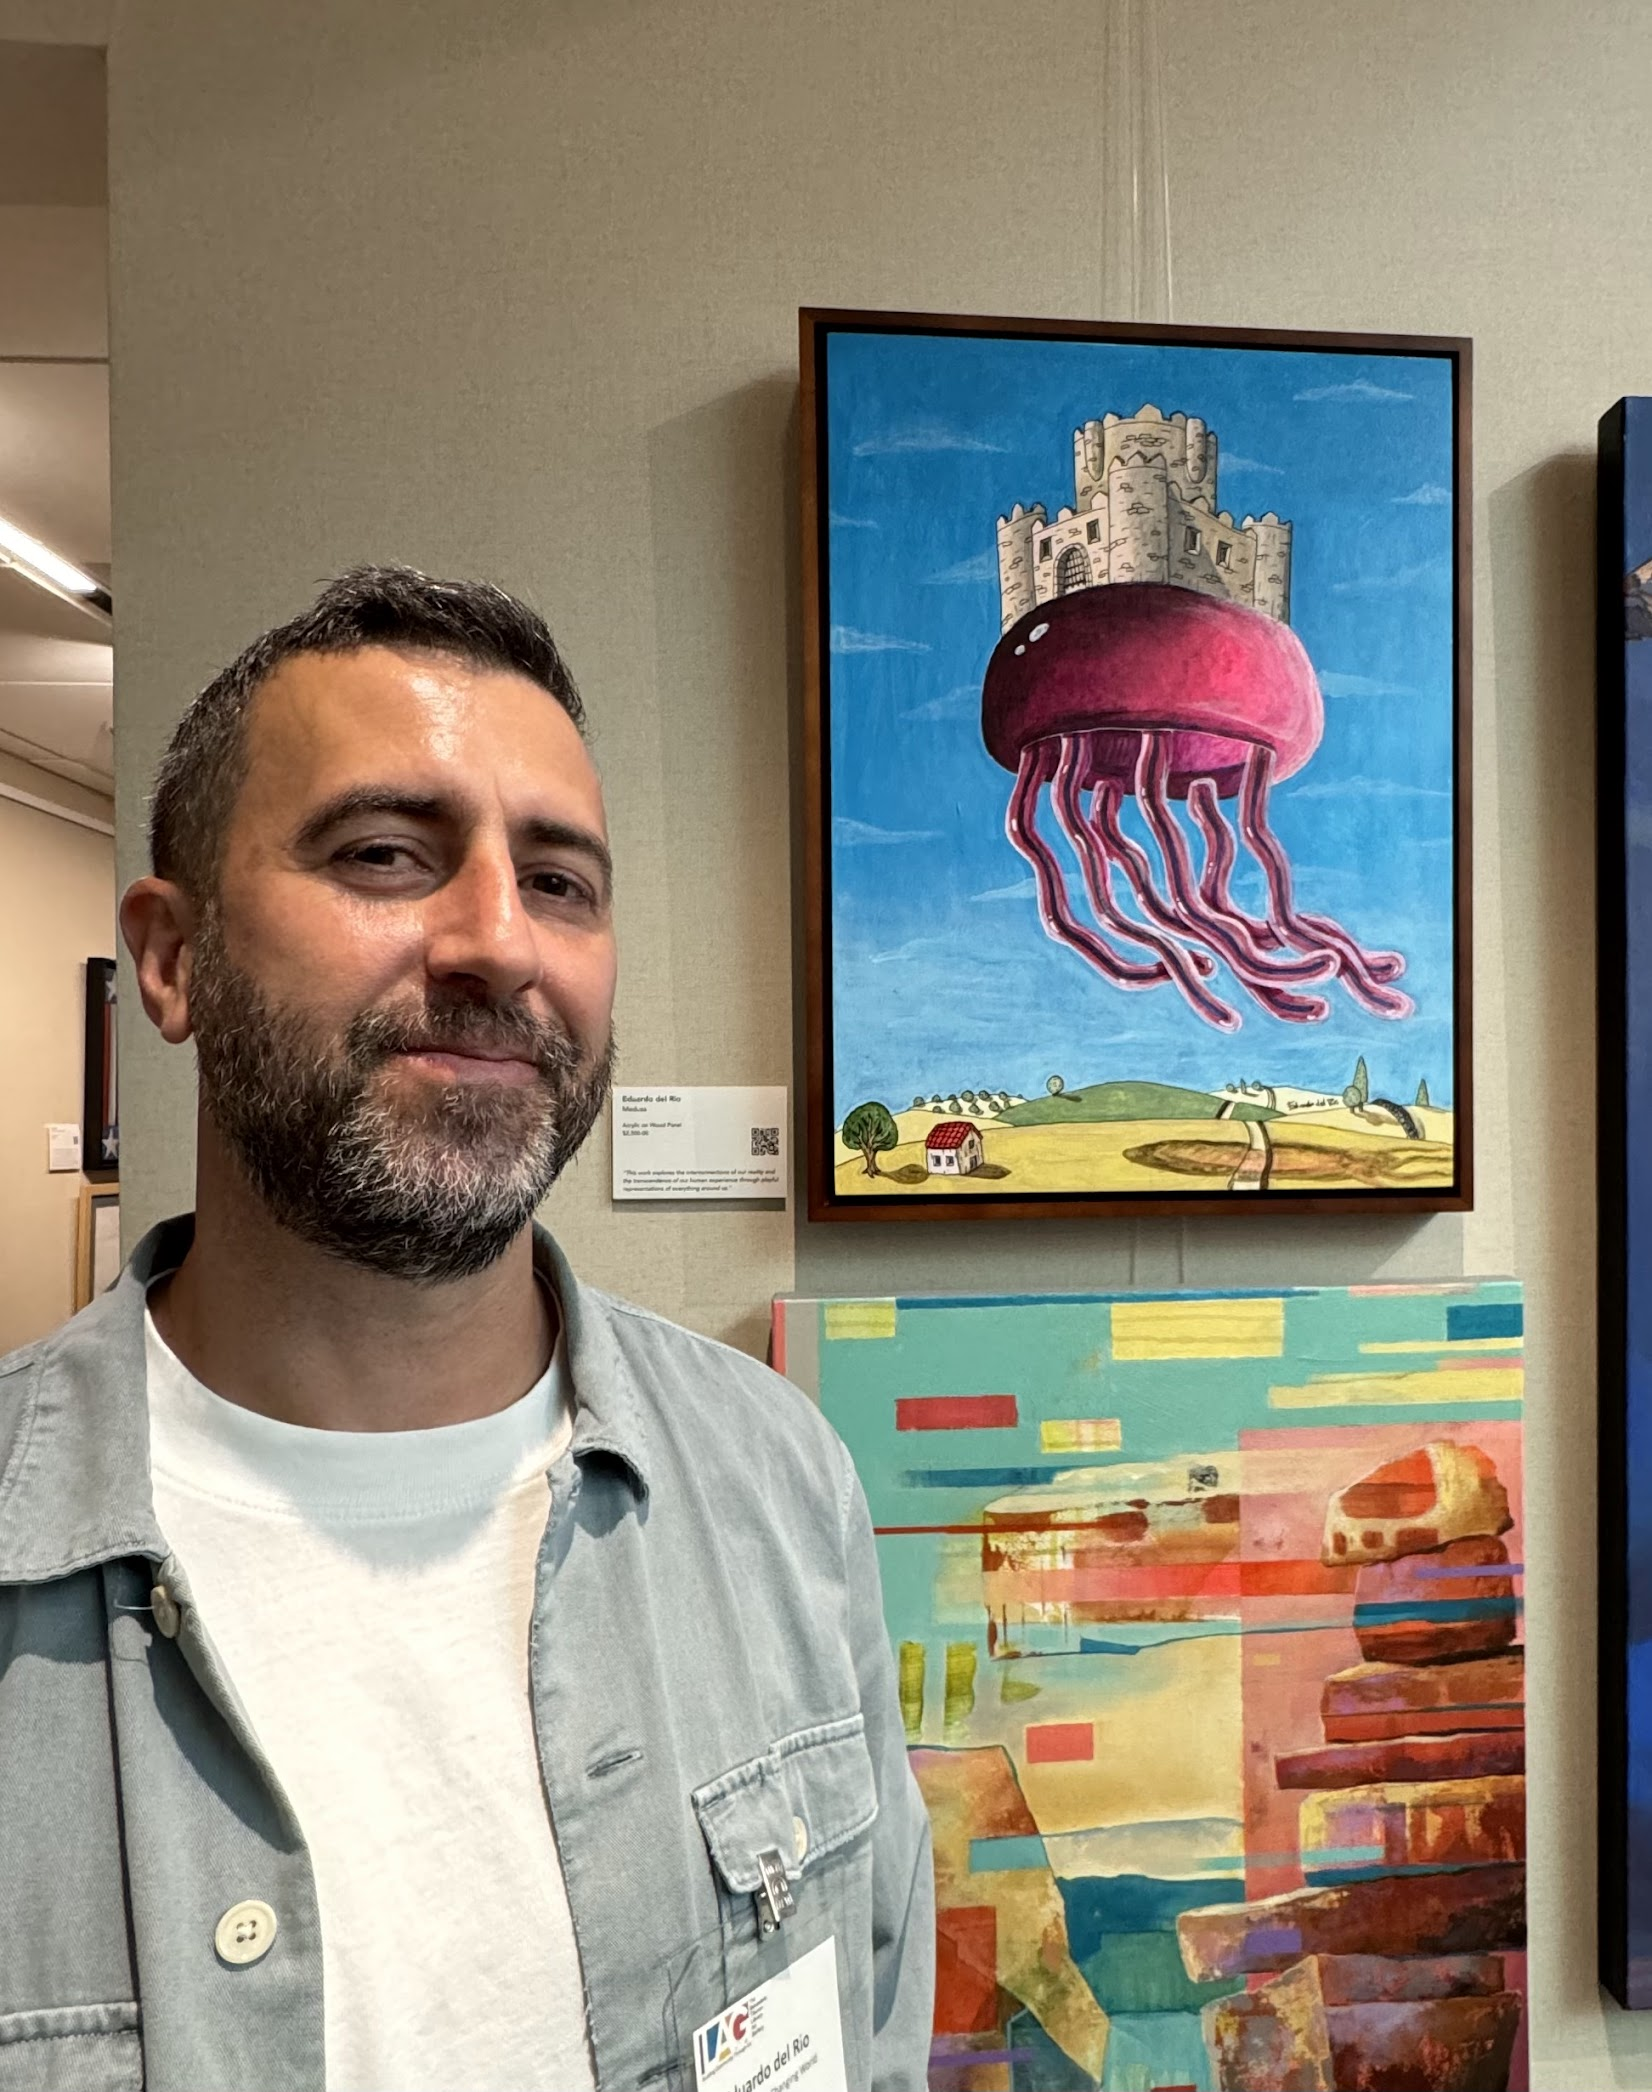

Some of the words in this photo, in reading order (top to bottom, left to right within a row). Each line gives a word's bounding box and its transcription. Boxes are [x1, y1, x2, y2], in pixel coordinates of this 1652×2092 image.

[622, 1095, 653, 1103] Eduardo
[655, 1095, 667, 1103] del
[669, 1095, 681, 1103] Rio
[774, 2043, 791, 2073] del
[793, 2033, 810, 2057] Rio
[799, 2052, 818, 2076] World
